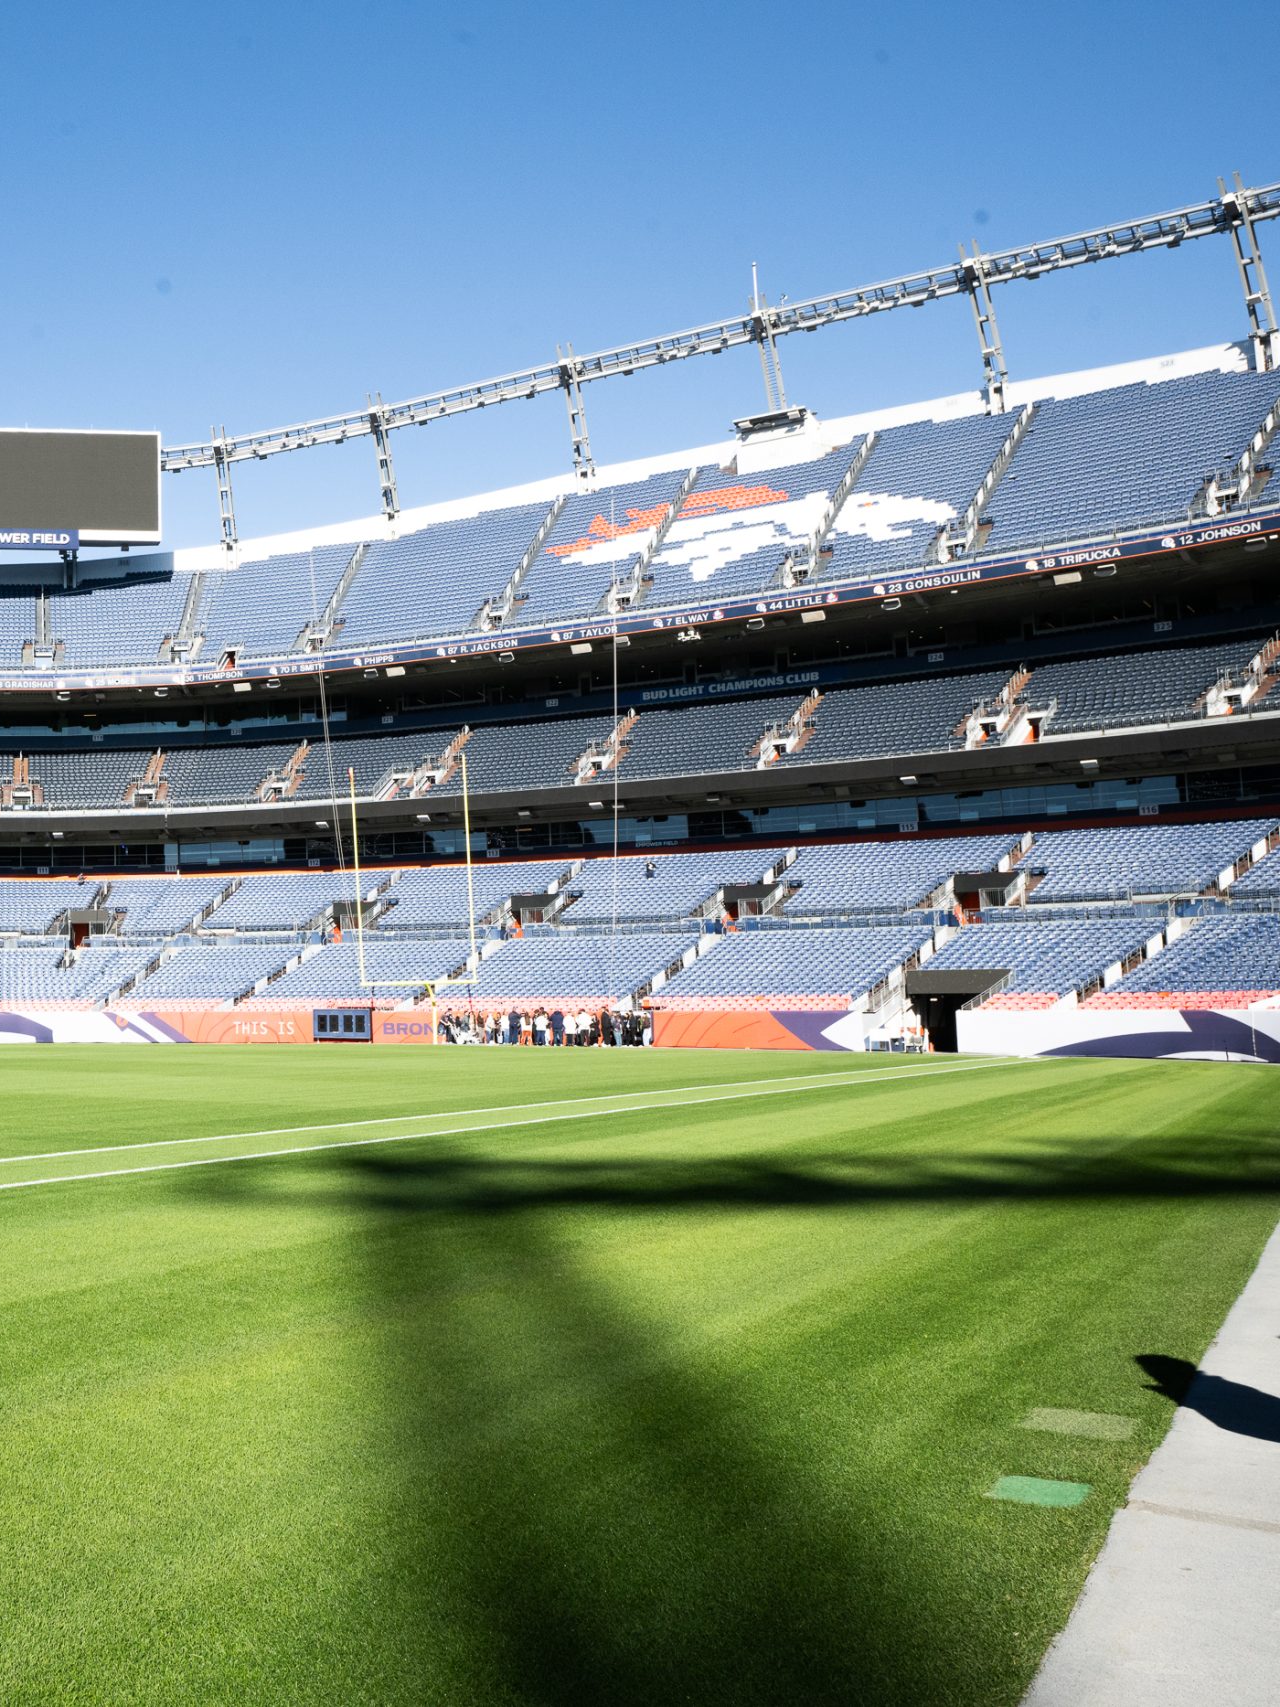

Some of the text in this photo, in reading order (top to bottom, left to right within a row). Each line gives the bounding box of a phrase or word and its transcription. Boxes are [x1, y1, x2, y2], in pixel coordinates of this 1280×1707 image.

[32, 533, 70, 545] FIELD
[1179, 521, 1261, 546] 12 JOHNSON
[1042, 547, 1121, 568] 18 TRIPUCKA
[888, 570, 980, 593] 23 GONSOULIN
[769, 596, 821, 610] 44 LITTLE
[666, 613, 709, 626] 7 ELWAY
[563, 625, 618, 641] 87 TAYLOR
[447, 639, 519, 655] 87 R. JACKSON
[365, 655, 394, 666] PHIPPS
[280, 665, 290, 674] 70
[300, 662, 325, 672] SMITH
[197, 671, 243, 682] THOMPSON
[4, 680, 54, 689] GRADISHAR
[642, 672, 819, 702] BUD LIGHT CHAMPIONS CLUB
[1141, 806, 1157, 815] 116
[901, 824, 914, 832] 115
[233, 1021, 295, 1035] THIS IS
